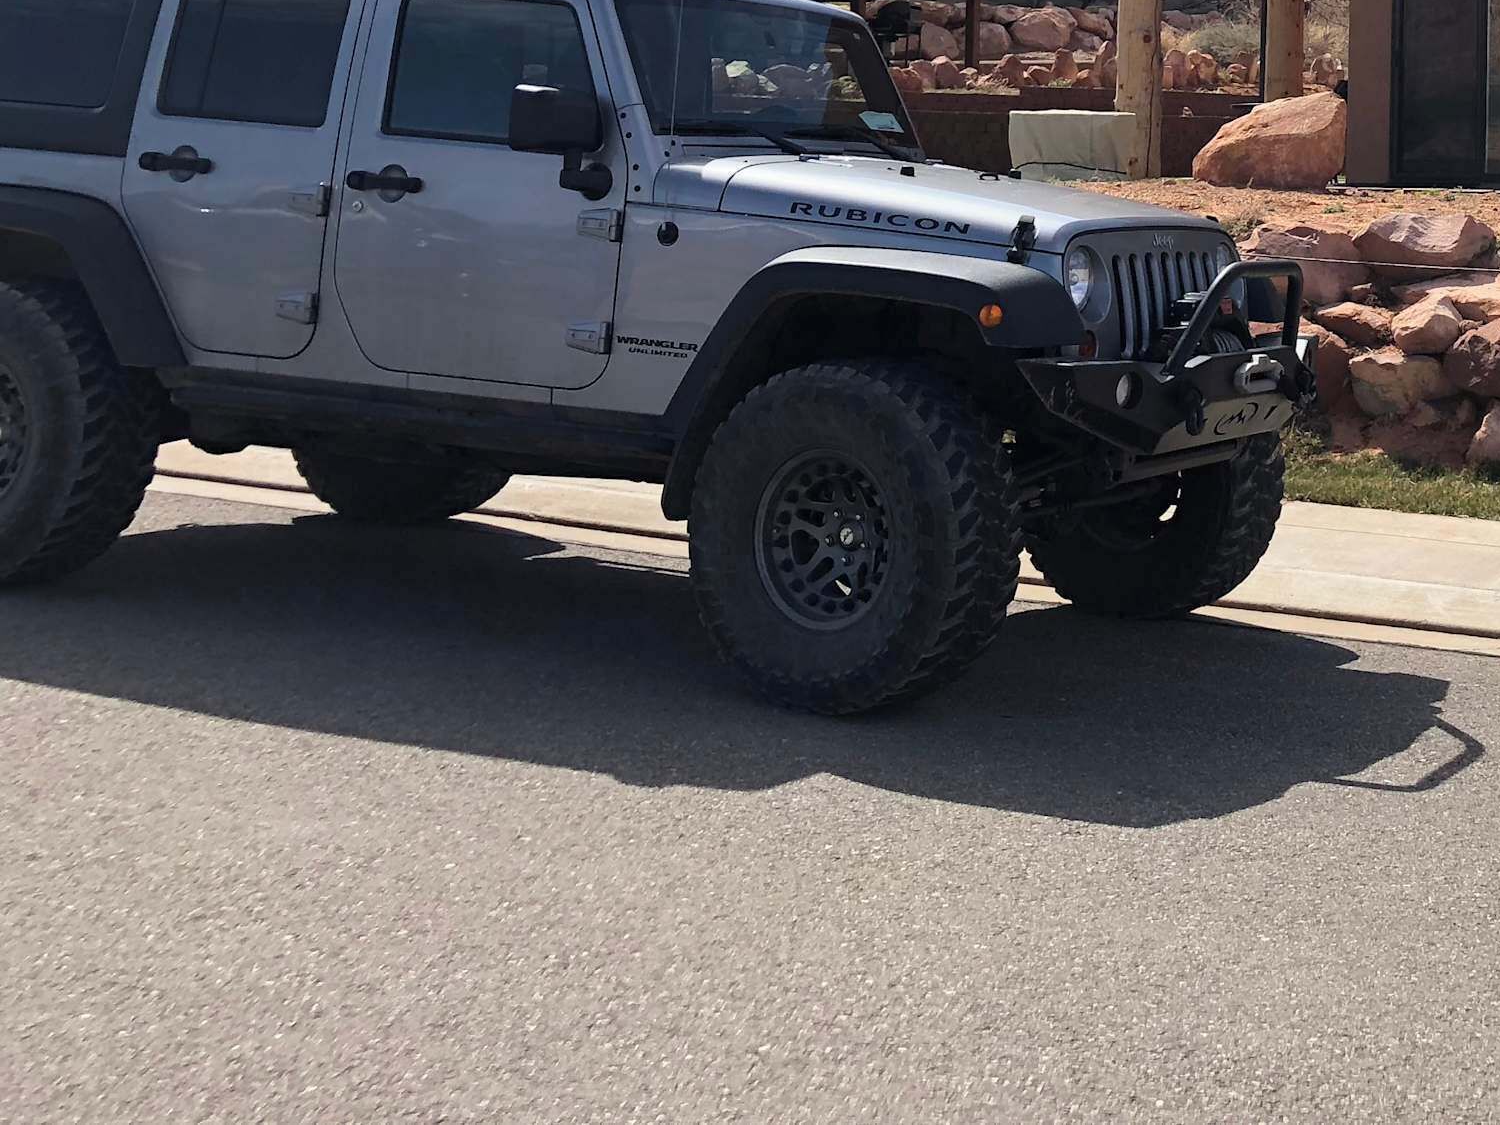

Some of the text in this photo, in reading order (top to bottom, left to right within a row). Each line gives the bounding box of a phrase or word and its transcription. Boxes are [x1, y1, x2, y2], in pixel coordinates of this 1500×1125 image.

[789, 201, 971, 235] RUBICON
[616, 335, 699, 353] WRANGLER
[628, 346, 688, 359] UNLIMITED
